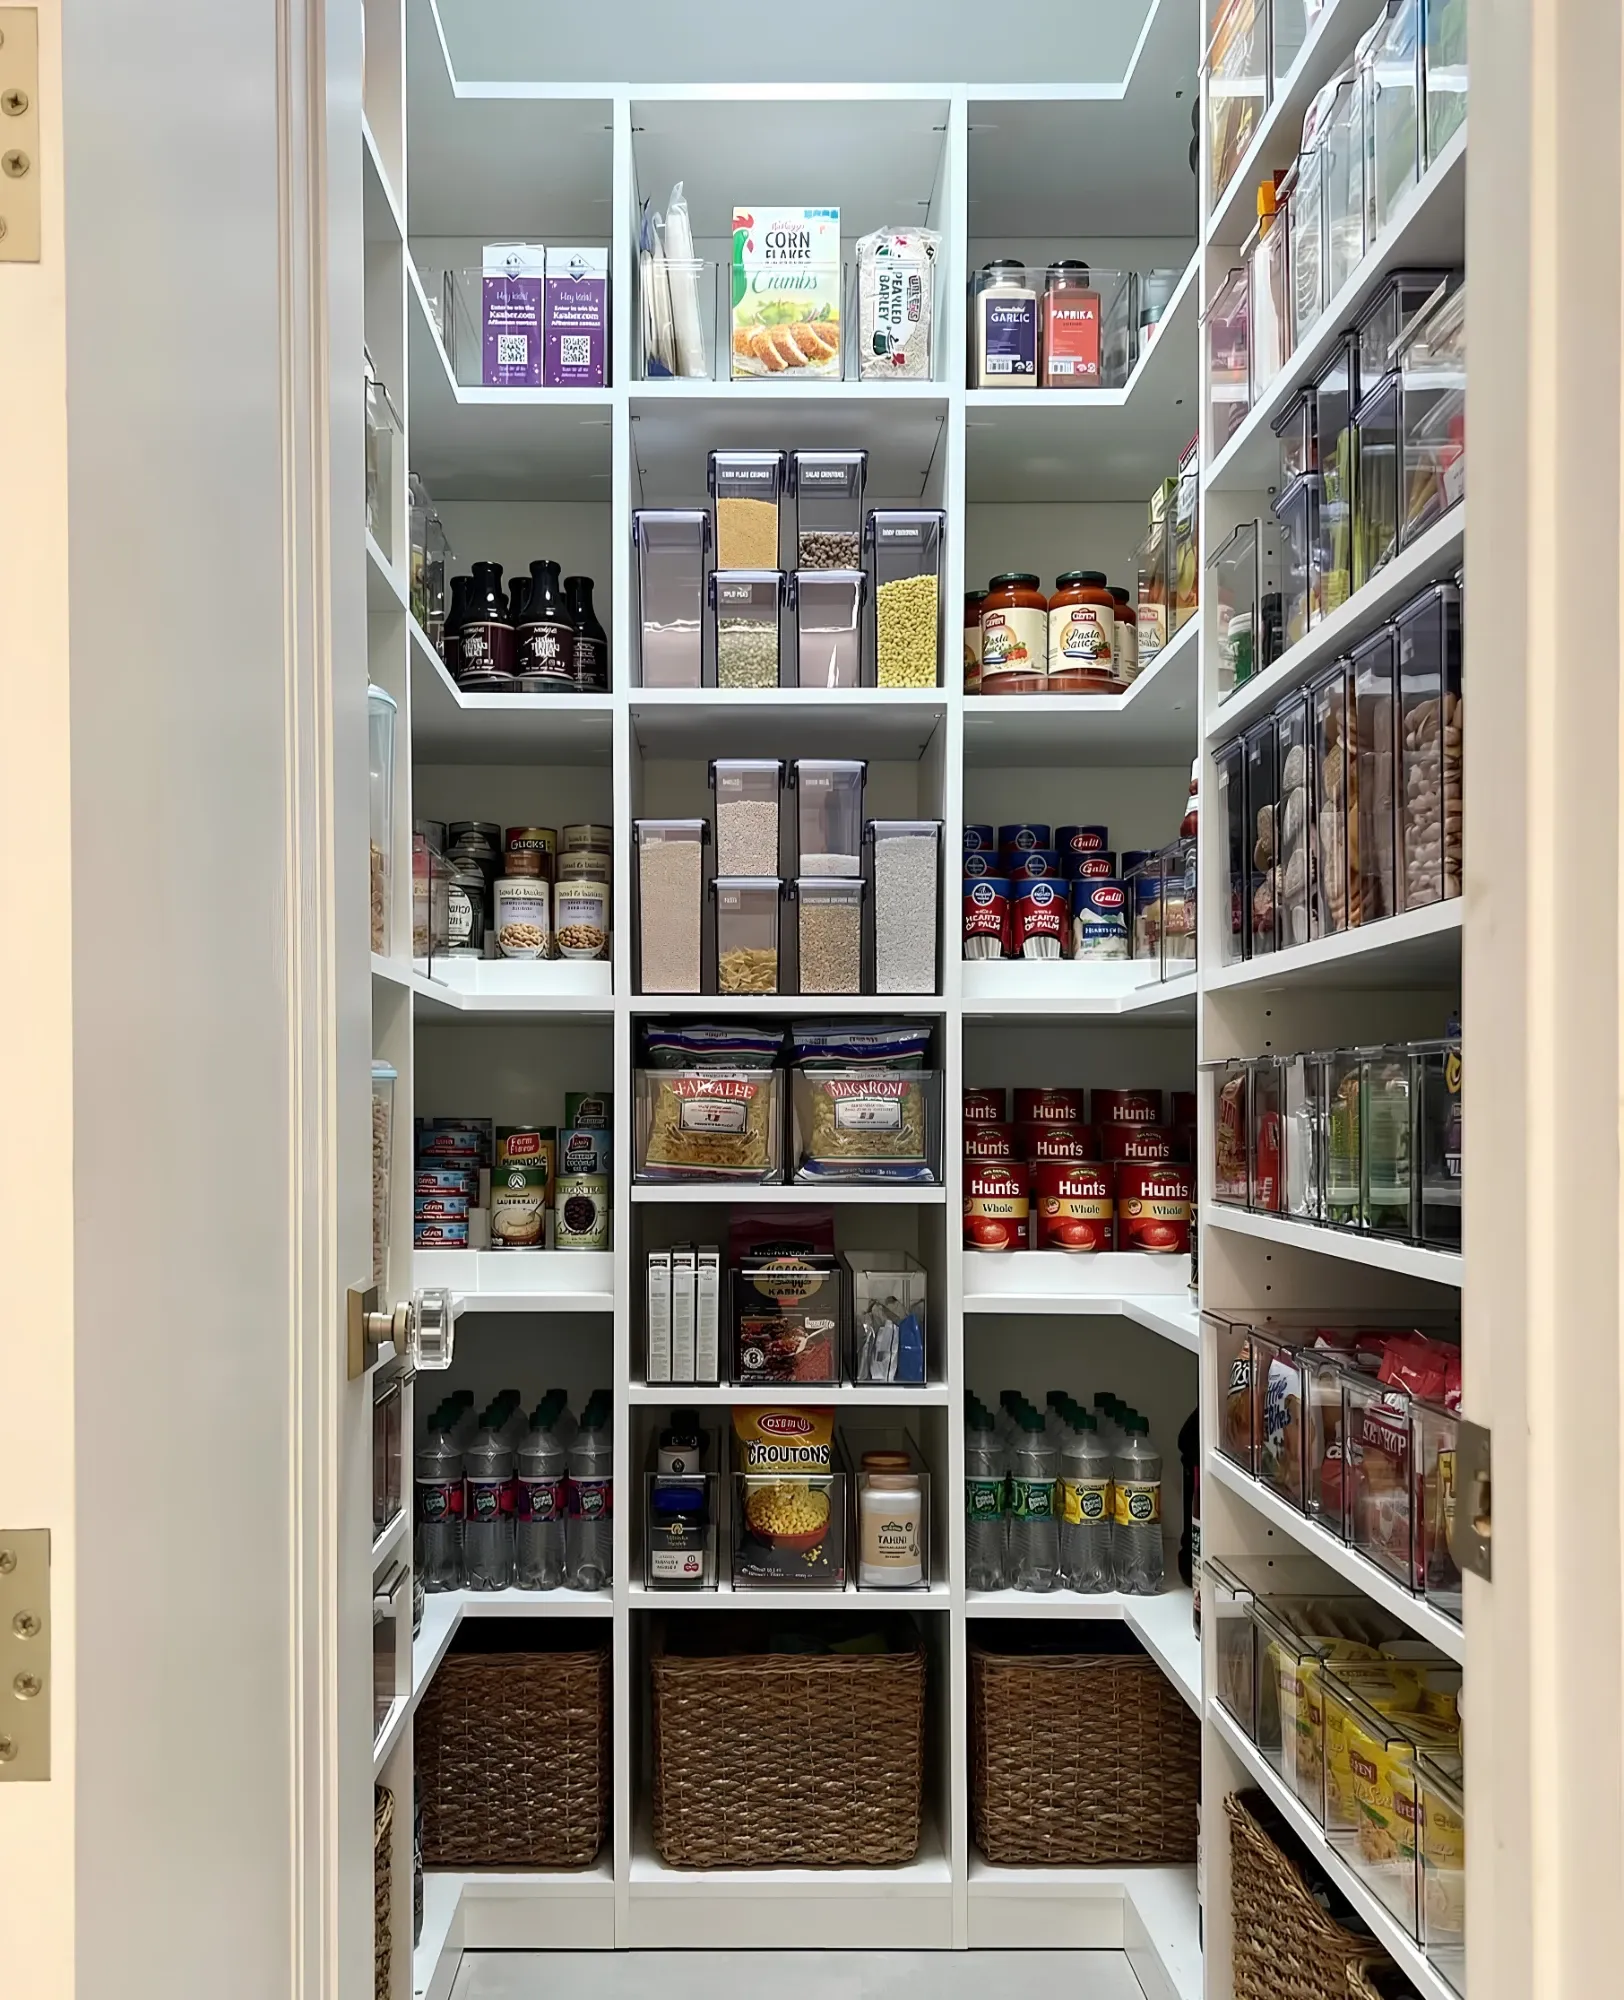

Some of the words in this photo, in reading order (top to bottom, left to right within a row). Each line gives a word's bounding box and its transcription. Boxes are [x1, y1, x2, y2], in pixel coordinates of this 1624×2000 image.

[765, 231, 810, 248] CORN
[878, 274, 890, 321] BARLEY
[990, 312, 1030, 323] GARLIC
[1051, 310, 1094, 320] PAPRIKA
[1070, 628, 1101, 642] Pasta
[1094, 891, 1122, 902] Galil
[1024, 914, 1060, 924] HEARTS
[978, 921, 1001, 931] PALM
[1037, 921, 1060, 931] PALM
[511, 1137, 533, 1145] Farm
[983, 1203, 1013, 1213] Whole
[1070, 1204, 1100, 1214] Whole
[1152, 1205, 1183, 1215] Whole
[748, 1444, 830, 1465] CROUTONS
[878, 1535, 907, 1544] TAHINI
